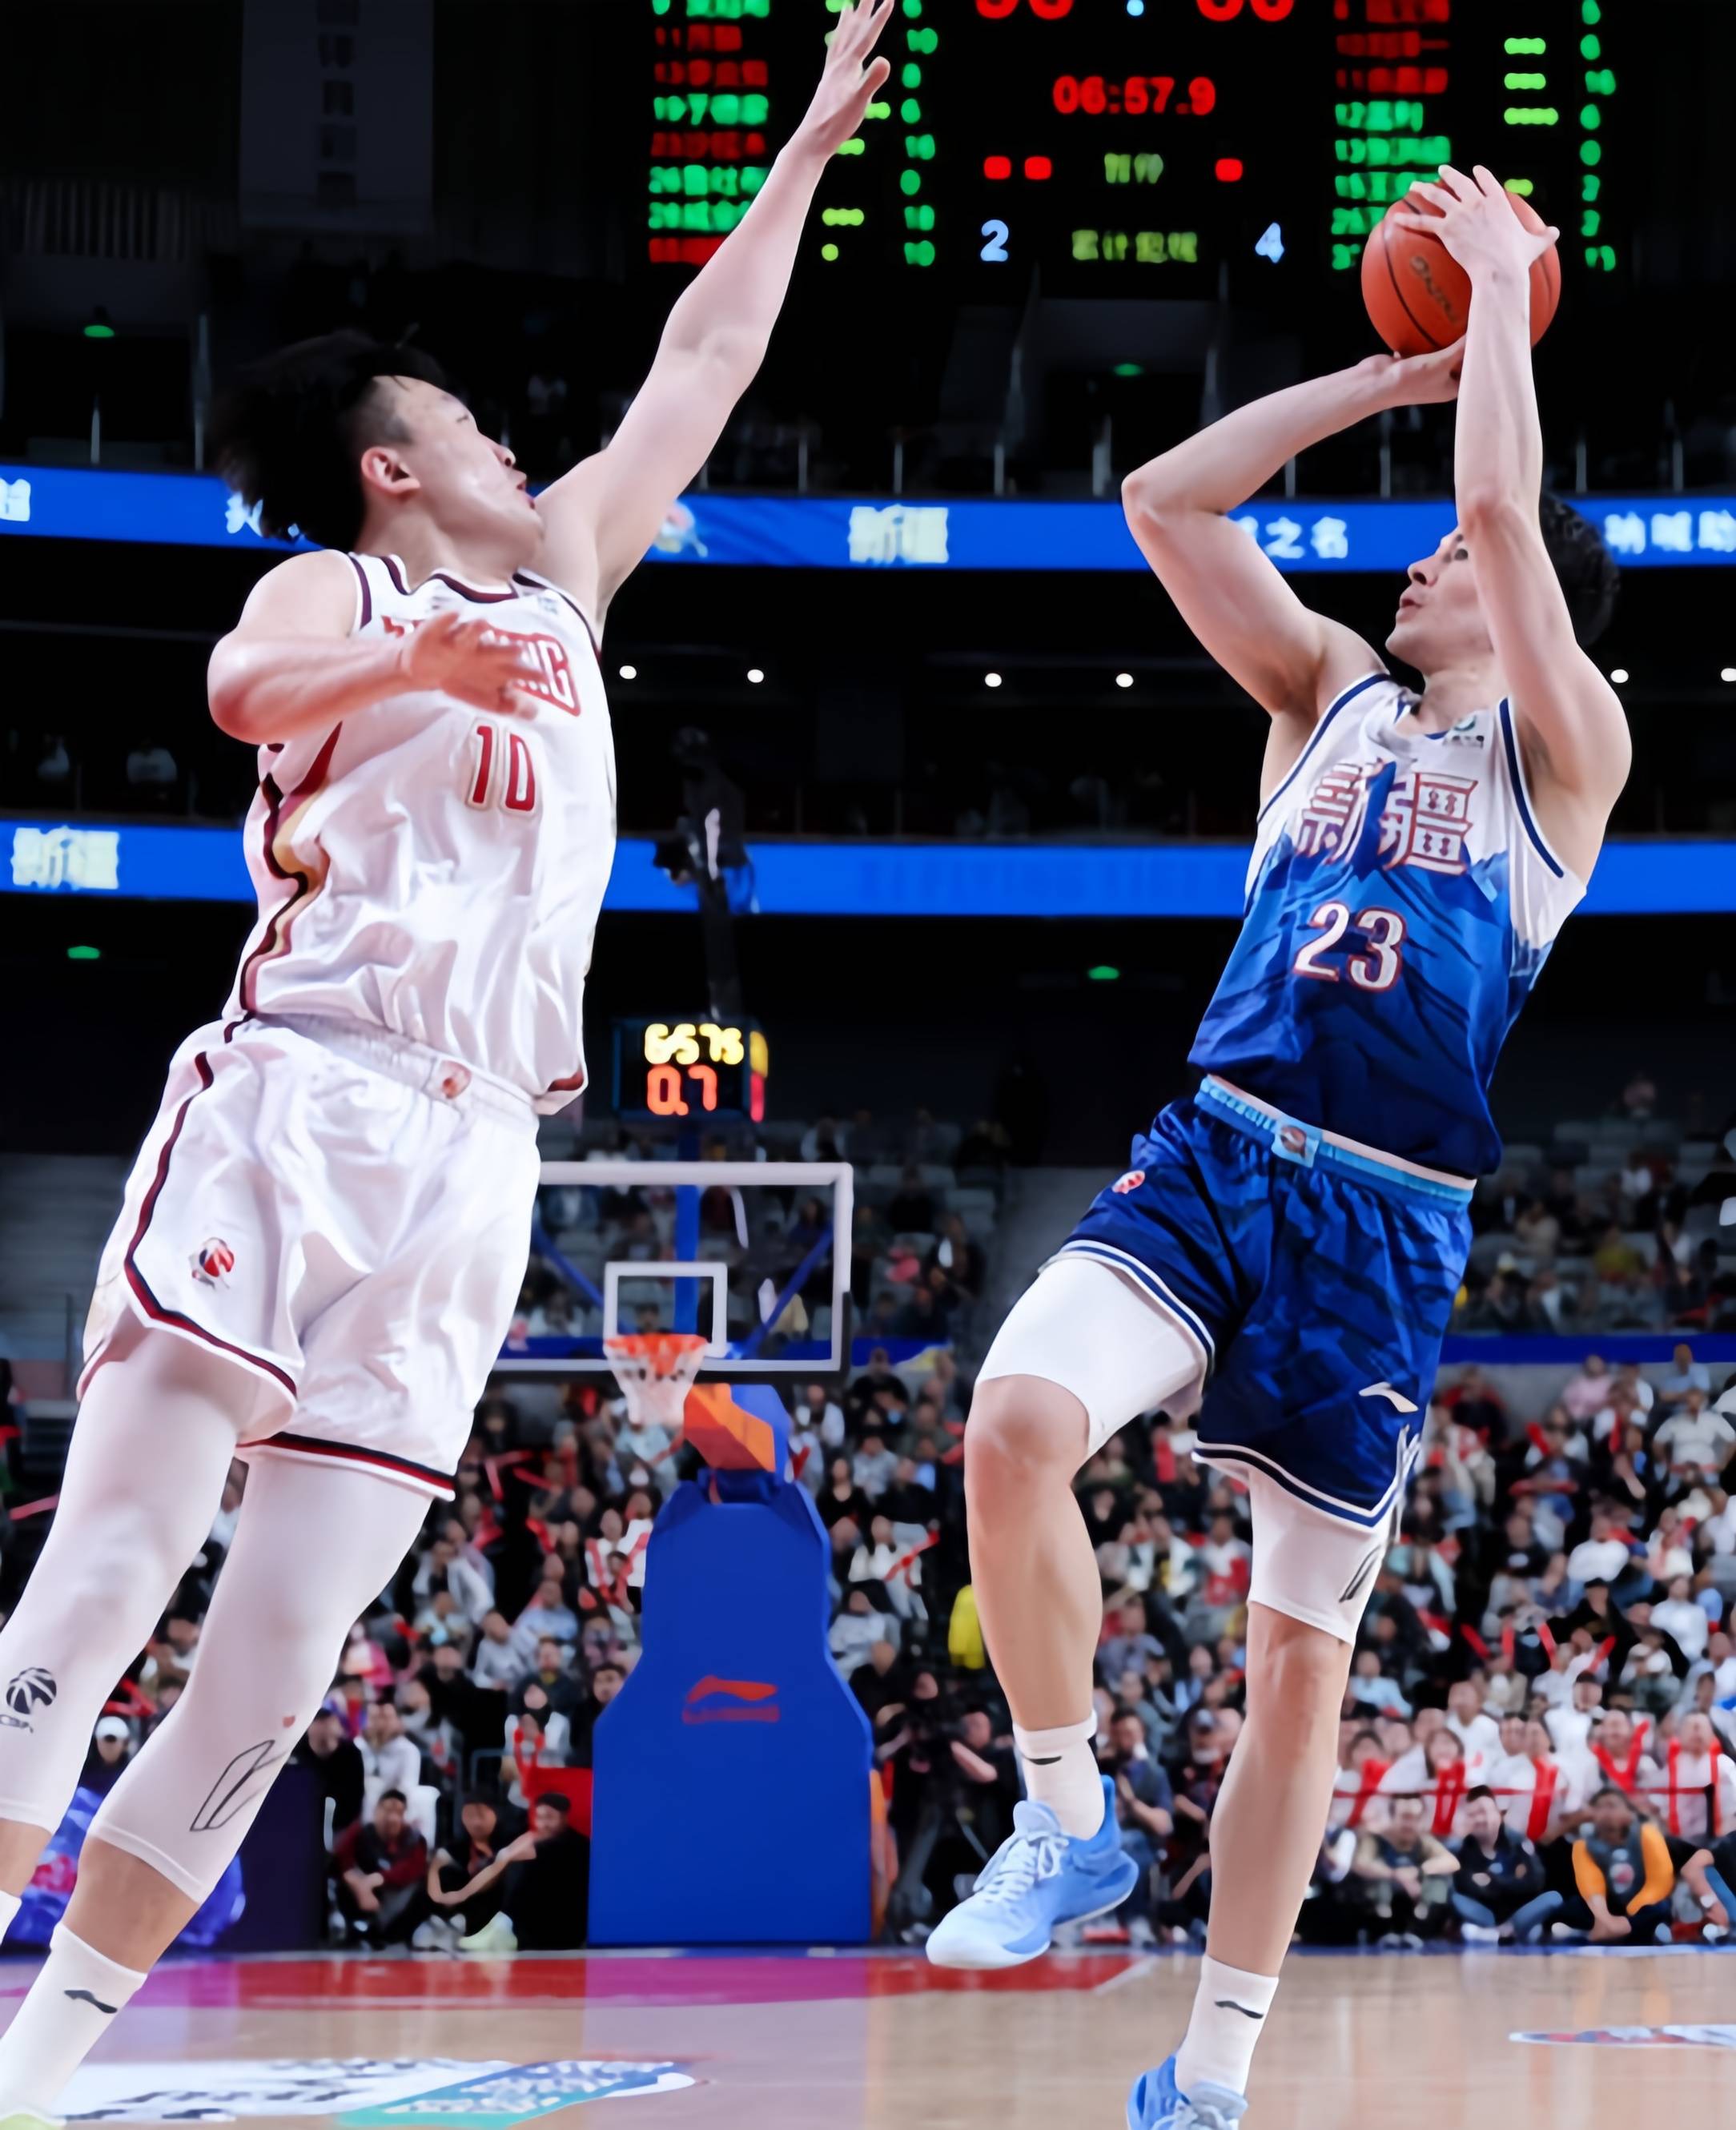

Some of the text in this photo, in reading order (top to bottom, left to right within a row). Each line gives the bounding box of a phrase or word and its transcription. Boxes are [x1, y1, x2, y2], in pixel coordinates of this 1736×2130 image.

[980, 219, 1009, 262] 2
[1255, 222, 1284, 263] 4
[469, 722, 537, 812] 10
[1292, 900, 1407, 991] 23
